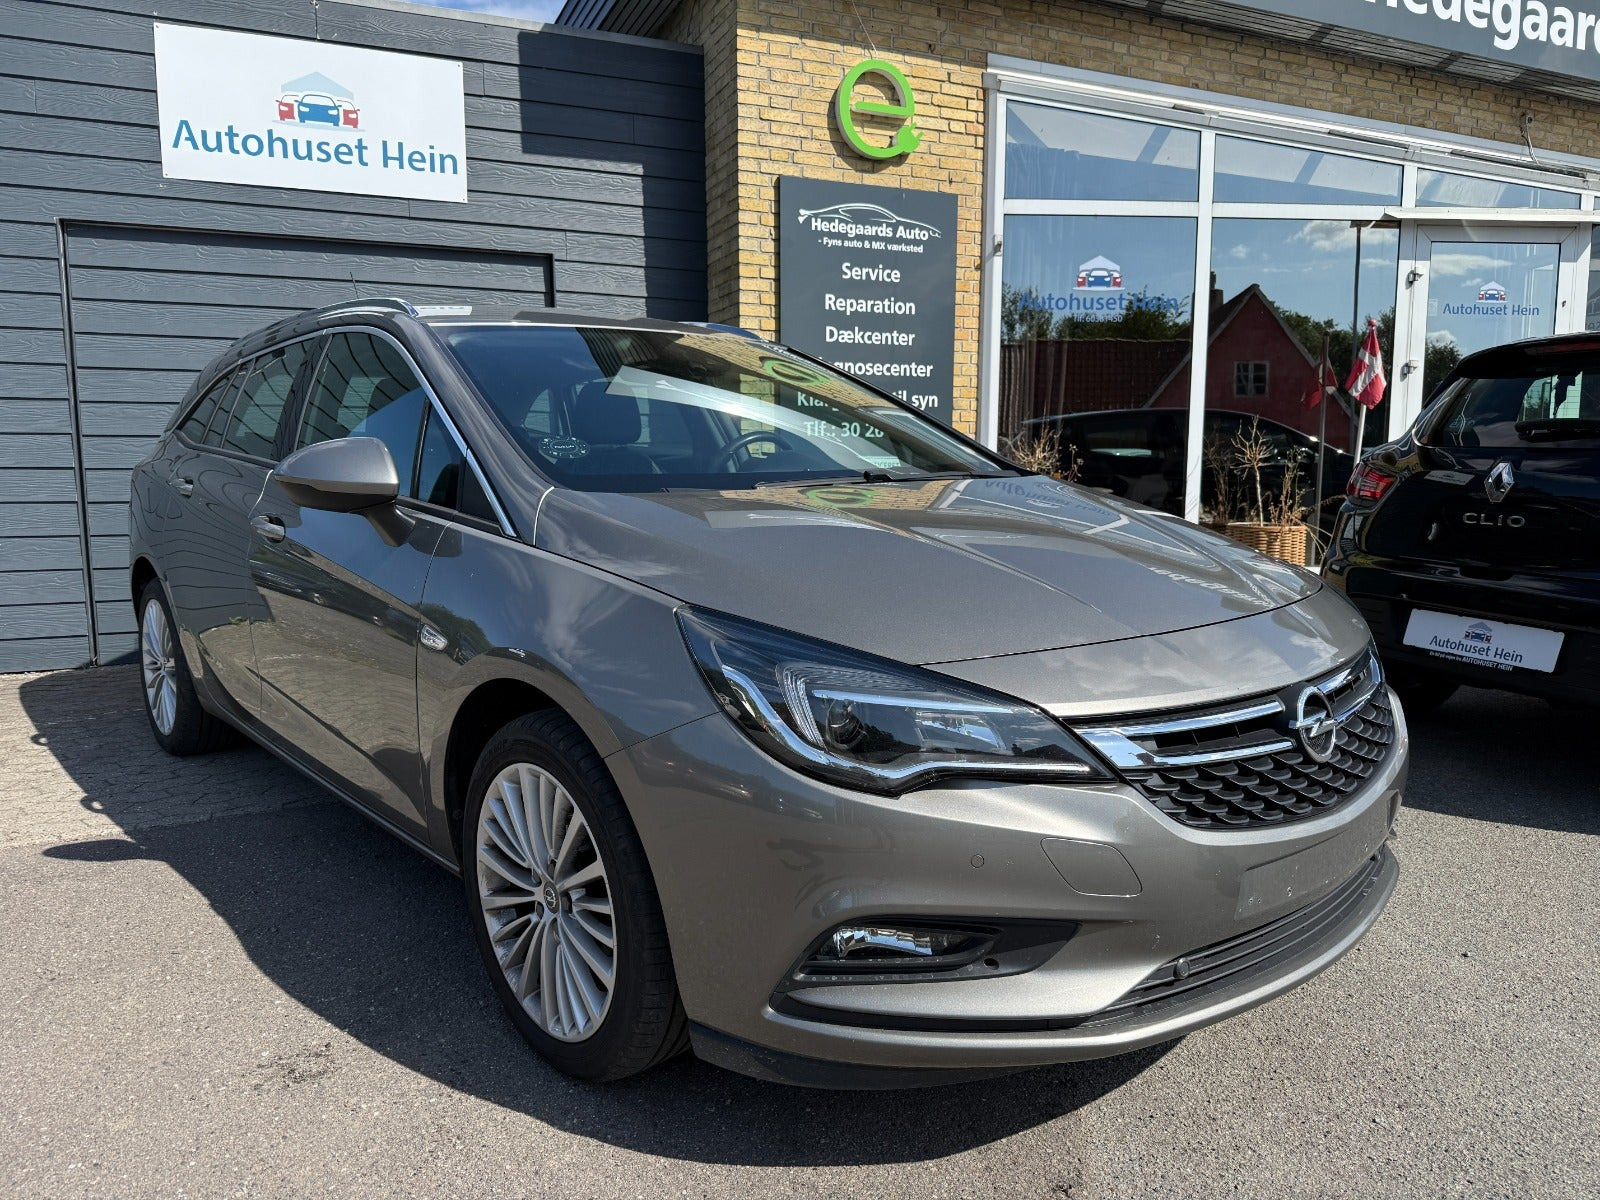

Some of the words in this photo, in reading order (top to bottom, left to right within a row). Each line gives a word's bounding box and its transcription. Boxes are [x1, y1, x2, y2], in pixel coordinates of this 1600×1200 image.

[172, 119, 369, 167] Autohuset
[381, 140, 458, 175] Hein
[811, 218, 894, 237] Hedegaards
[895, 226, 929, 241] Auto
[823, 237, 842, 248] Fyns
[843, 239, 863, 249] auto
[864, 240, 871, 249] &
[871, 241, 886, 250] MX
[886, 242, 924, 253] værksted
[842, 262, 901, 283] Service
[825, 294, 916, 315] Reparation
[1019, 293, 1125, 311] Autohuset
[1132, 294, 1179, 311] Hein
[1443, 303, 1507, 316] Autohuset
[1512, 304, 1540, 316] Hein
[826, 326, 915, 346] Dækcenter
[911, 395, 938, 411] syn
[841, 422, 860, 438] 30
[1429, 635, 1492, 657] Autohuset
[1494, 647, 1523, 663] Hein
[1462, 656, 1498, 668] AUTOHUSET
